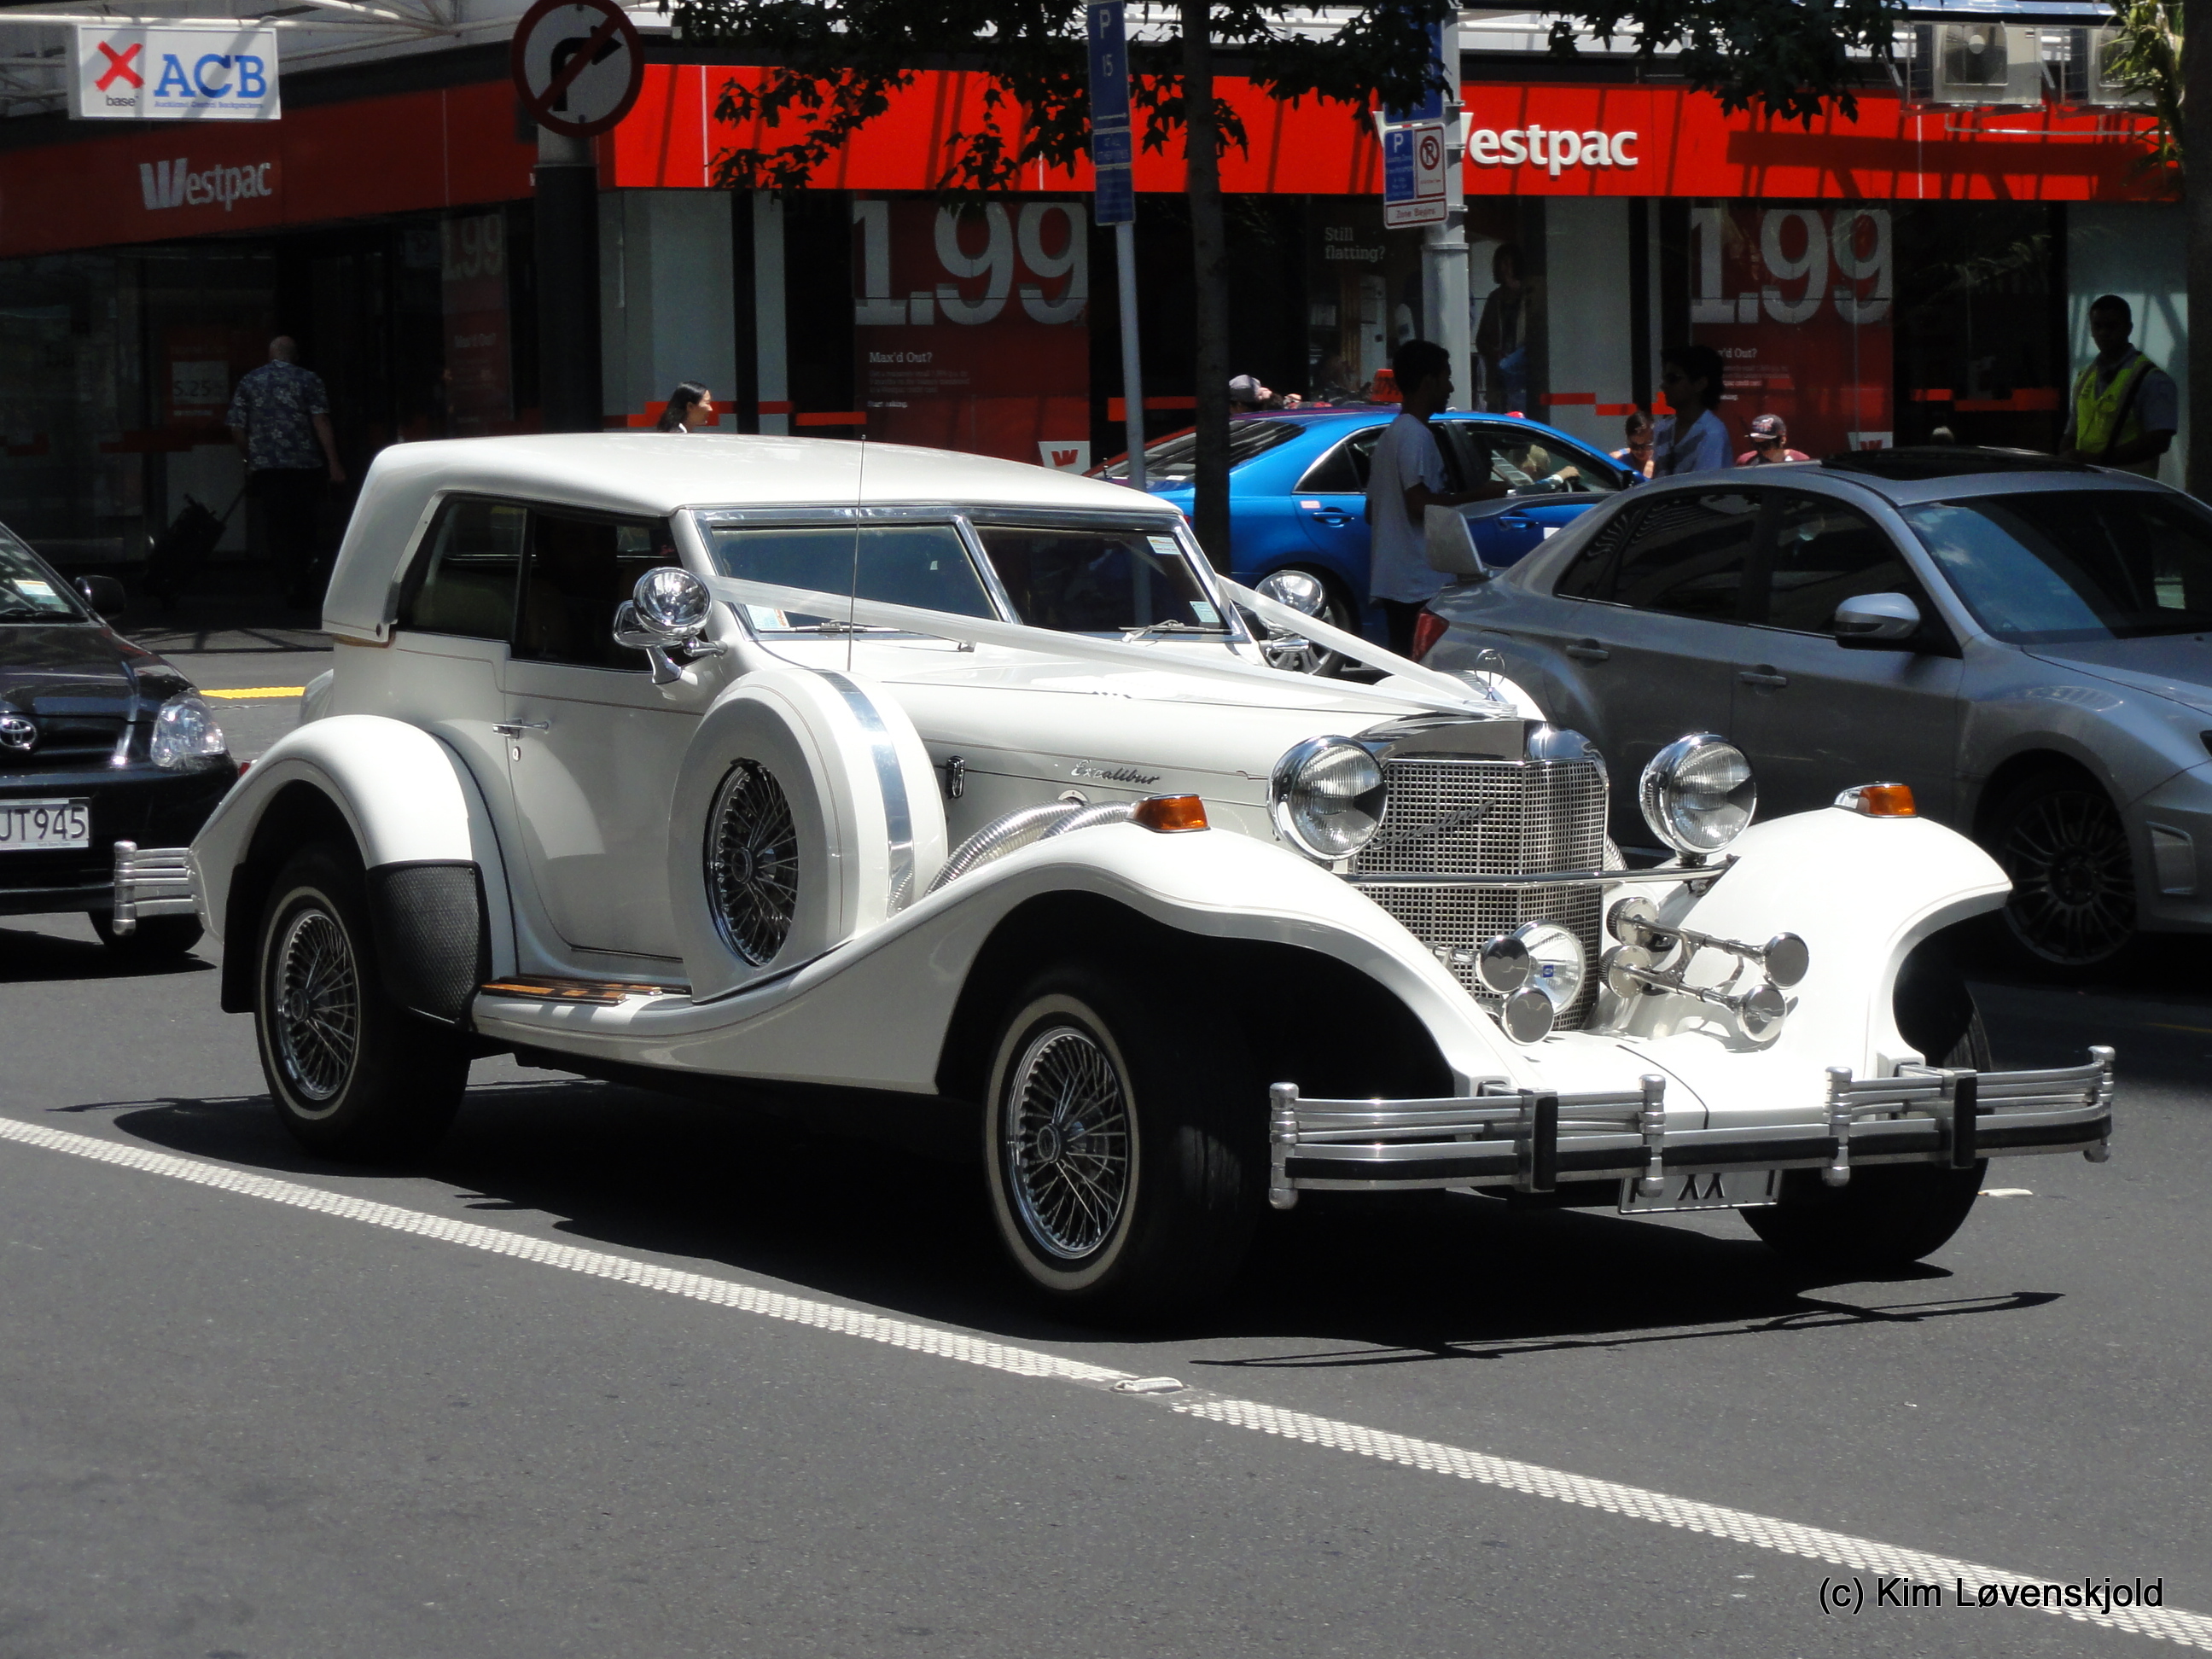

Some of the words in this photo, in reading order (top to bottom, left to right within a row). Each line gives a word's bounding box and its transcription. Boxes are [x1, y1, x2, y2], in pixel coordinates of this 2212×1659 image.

[1099, 9, 1111, 39] P
[154, 53, 268, 99] ACB
[106, 95, 137, 107] base
[138, 157, 272, 212] Westpac
[1324, 226, 1354, 242] Still
[854, 199, 1088, 326] 1.99
[1324, 244, 1386, 263] flatting?
[1691, 207, 1893, 324] 1.99
[870, 352, 903, 363] Max'd
[906, 352, 933, 363] Out?
[1071, 759, 1161, 784] Excalibur
